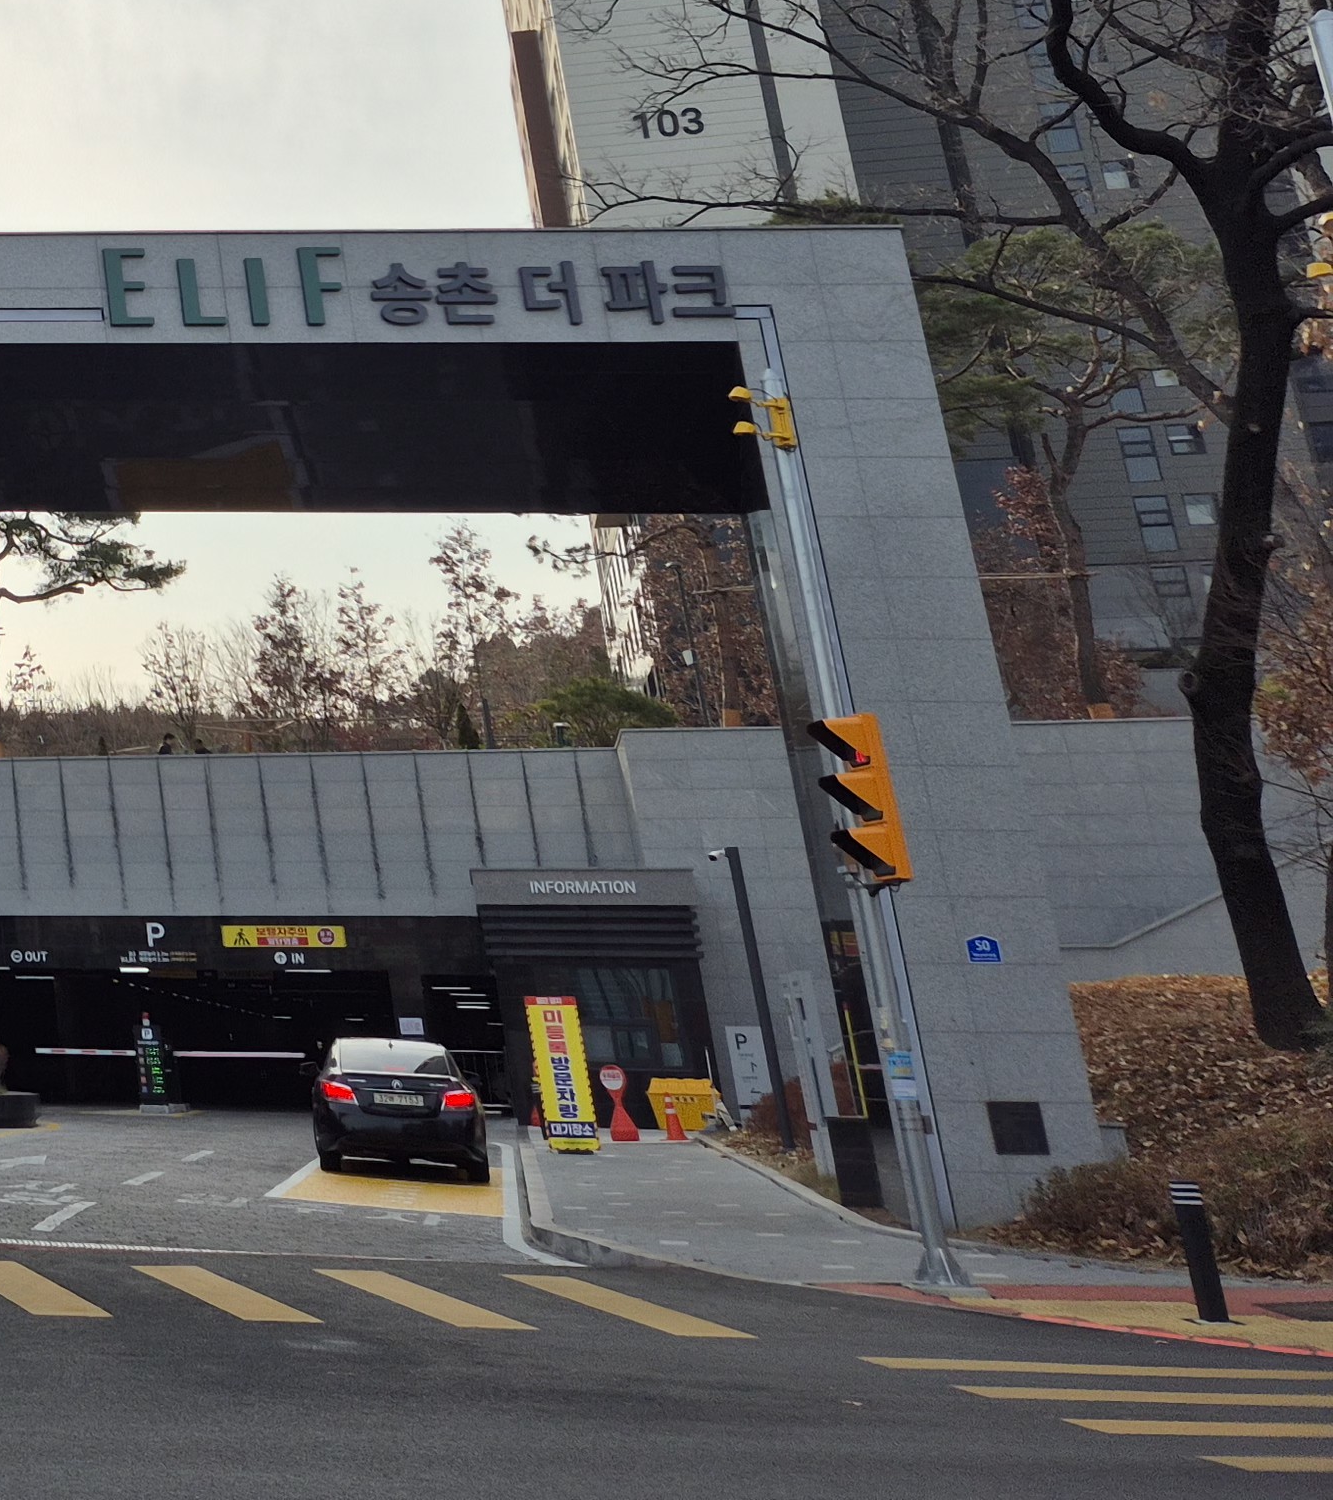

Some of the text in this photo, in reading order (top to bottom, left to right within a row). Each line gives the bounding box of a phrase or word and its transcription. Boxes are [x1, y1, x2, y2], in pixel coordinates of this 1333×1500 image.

[632, 107, 705, 139] 103
[102, 246, 738, 328] ELIF 송촌 더 파크
[529, 880, 637, 895] INFORMATION
[145, 922, 166, 948] P
[24, 951, 48, 963] OUT
[291, 952, 305, 965] IN
[734, 1032, 748, 1050] P
[550, 1121, 595, 1138] 대기장소
